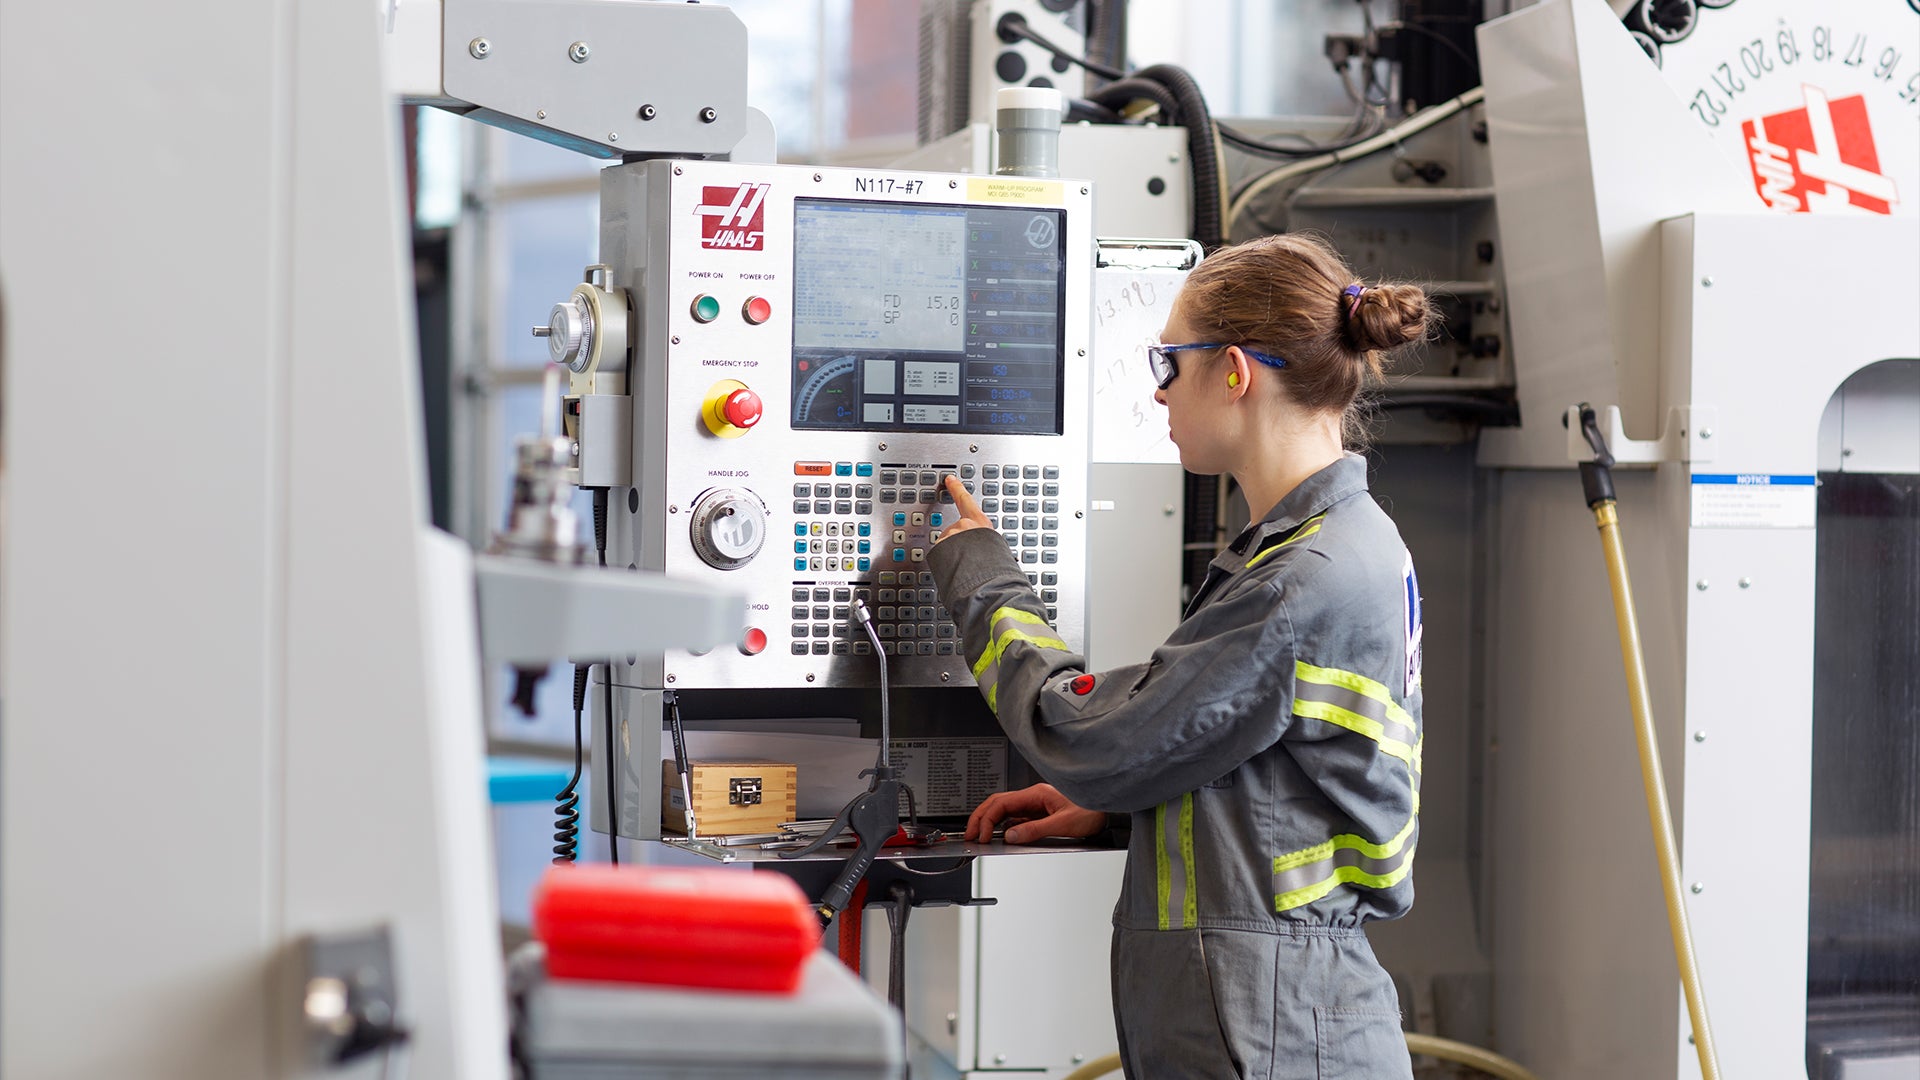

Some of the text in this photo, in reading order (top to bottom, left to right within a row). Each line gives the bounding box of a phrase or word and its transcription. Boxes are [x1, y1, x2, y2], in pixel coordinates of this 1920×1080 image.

[1778, 29, 1802, 66] 19
[1813, 25, 1835, 62] 18
[1844, 32, 1868, 68] 17
[1740, 38, 1774, 79] 20
[1873, 46, 1903, 82] 16
[1711, 62, 1746, 101] 21
[1690, 89, 1728, 127] 22
[855, 177, 925, 196] N117-#7
[702, 229, 764, 248] HAAS
[689, 271, 711, 279] POWER
[883, 294, 959, 310] FD 15.0
[883, 310, 902, 324] SP
[702, 360, 759, 368] EMERGENCY STOP
[1736, 475, 1771, 485] NOTICE
[1048, 592, 1052, 600] 6
[1062, 682, 1068, 693] FR
